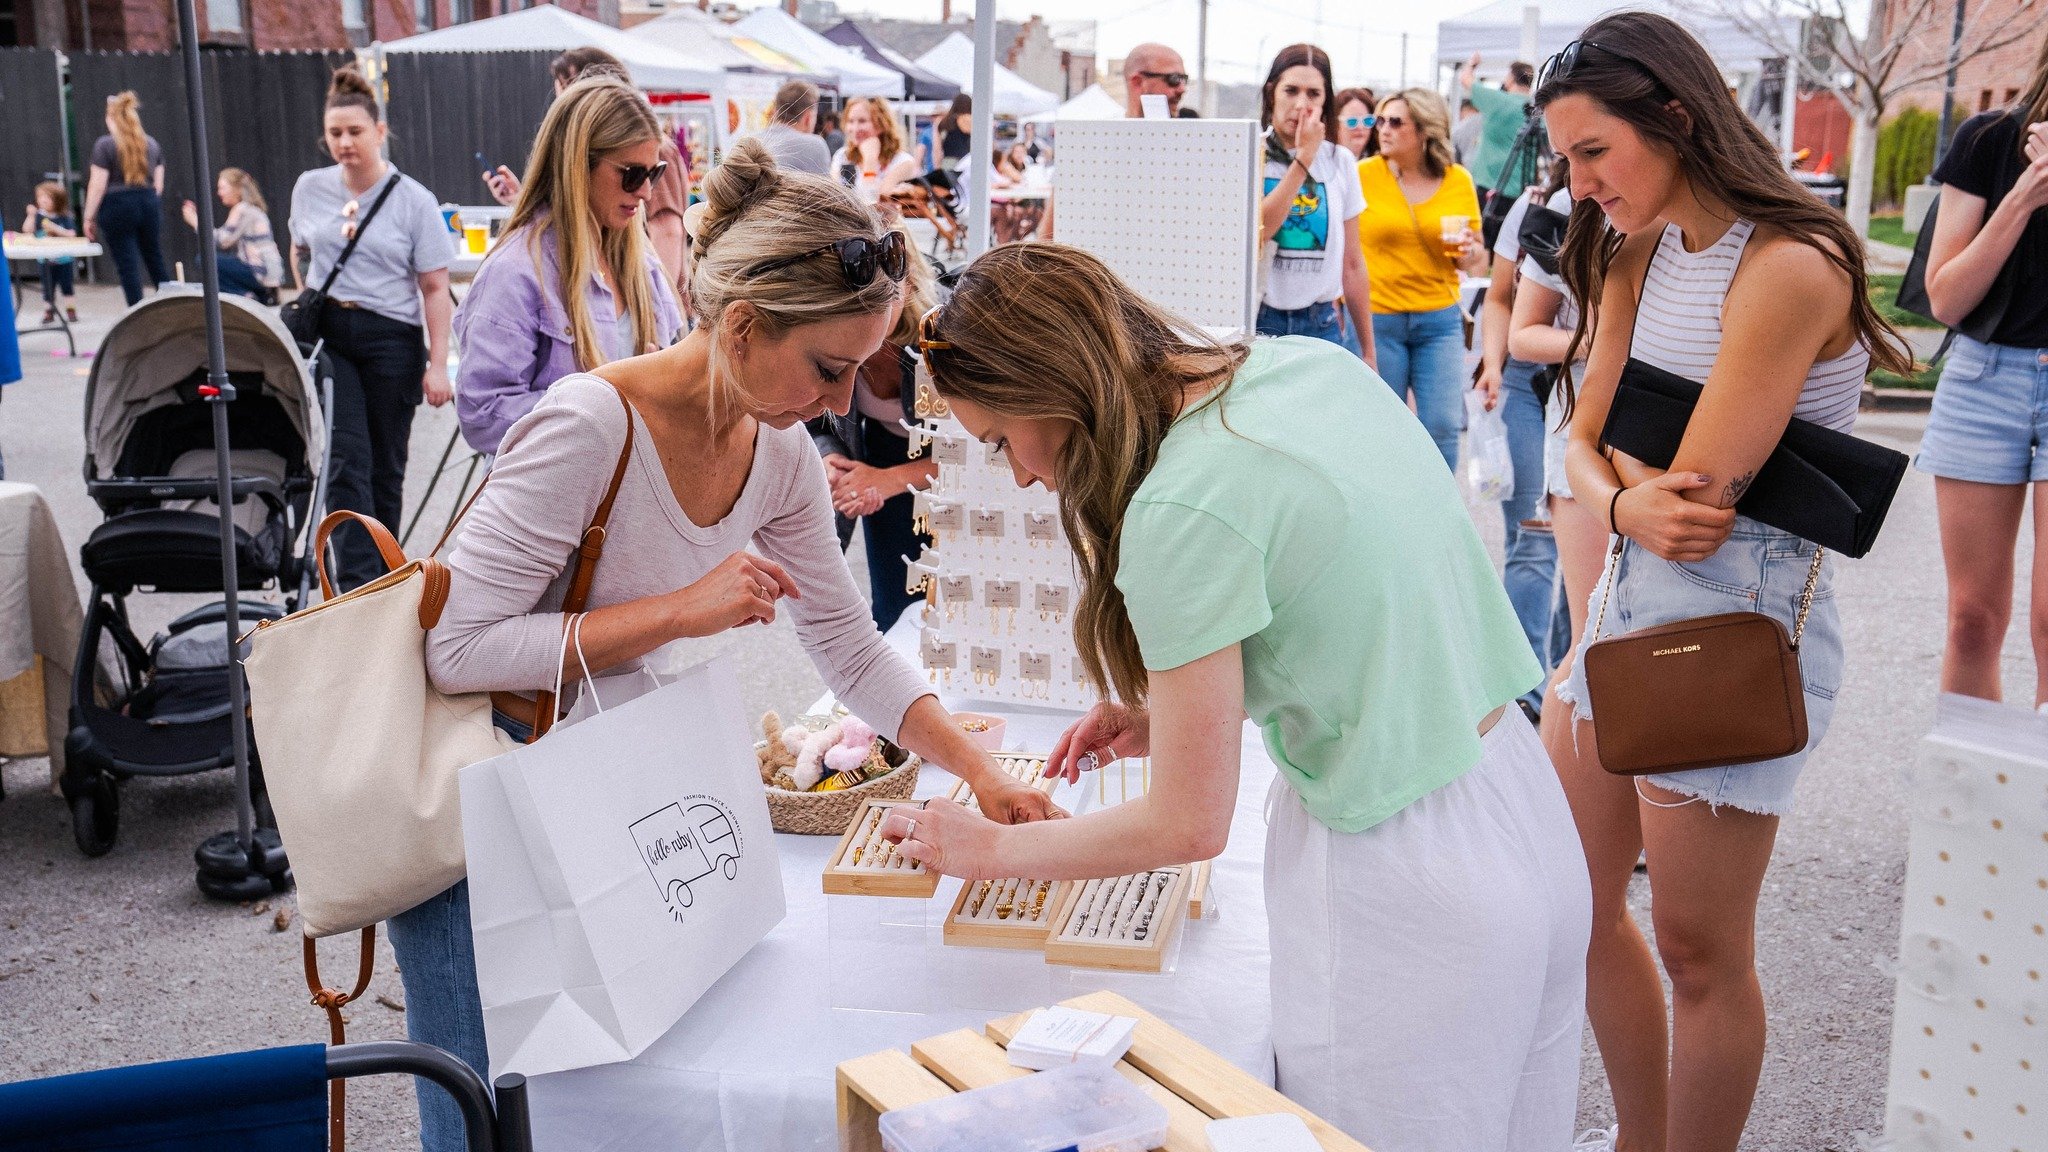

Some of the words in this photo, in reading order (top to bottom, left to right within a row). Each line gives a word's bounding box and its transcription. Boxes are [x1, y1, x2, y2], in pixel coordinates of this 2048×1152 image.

[1653, 647, 1682, 657] MICHAEL
[1682, 644, 1701, 653] KORS
[708, 795, 725, 807] TRUCK
[646, 837, 671, 866] hello
[671, 830, 693, 853] ruby
